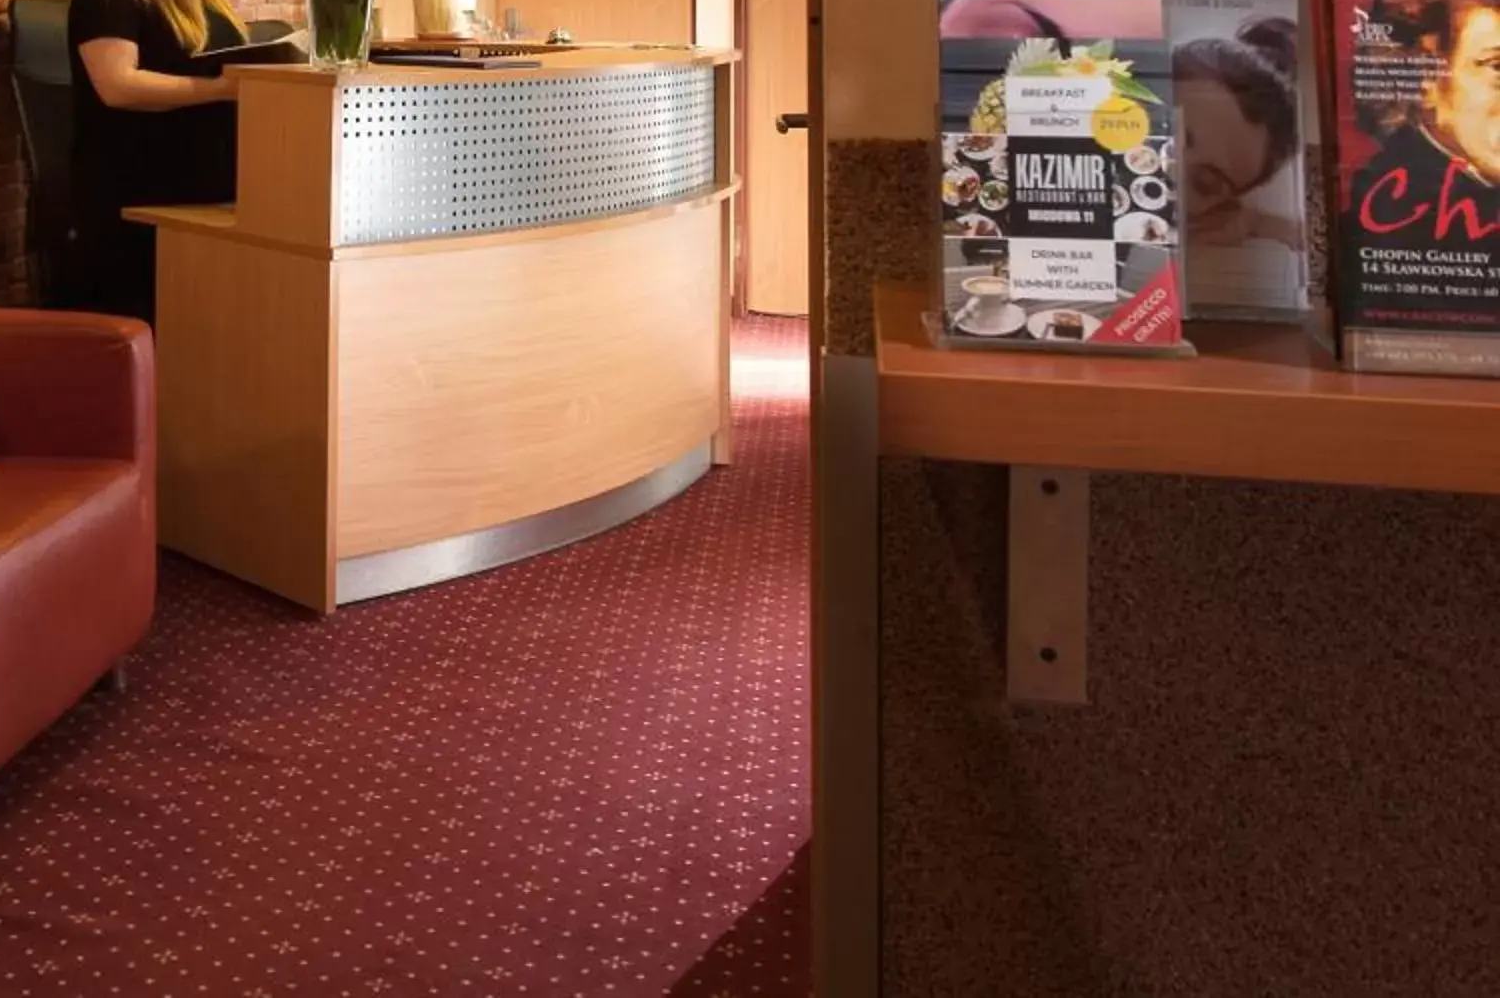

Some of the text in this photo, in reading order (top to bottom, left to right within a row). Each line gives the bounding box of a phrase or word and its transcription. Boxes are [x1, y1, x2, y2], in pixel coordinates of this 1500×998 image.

[1021, 88, 1086, 98] BREAKFAST
[1029, 117, 1080, 126] BRUNCH
[1015, 153, 1105, 190] KAZIMIR
[1031, 249, 1093, 259] DRINK BAR
[1359, 247, 1492, 264] CHOPIN GALLERY
[1046, 265, 1079, 275] WITH
[1361, 261, 1379, 273] 14
[1013, 279, 1115, 290] SUMMER GARDEN
[1113, 287, 1168, 337] PROSECCO
